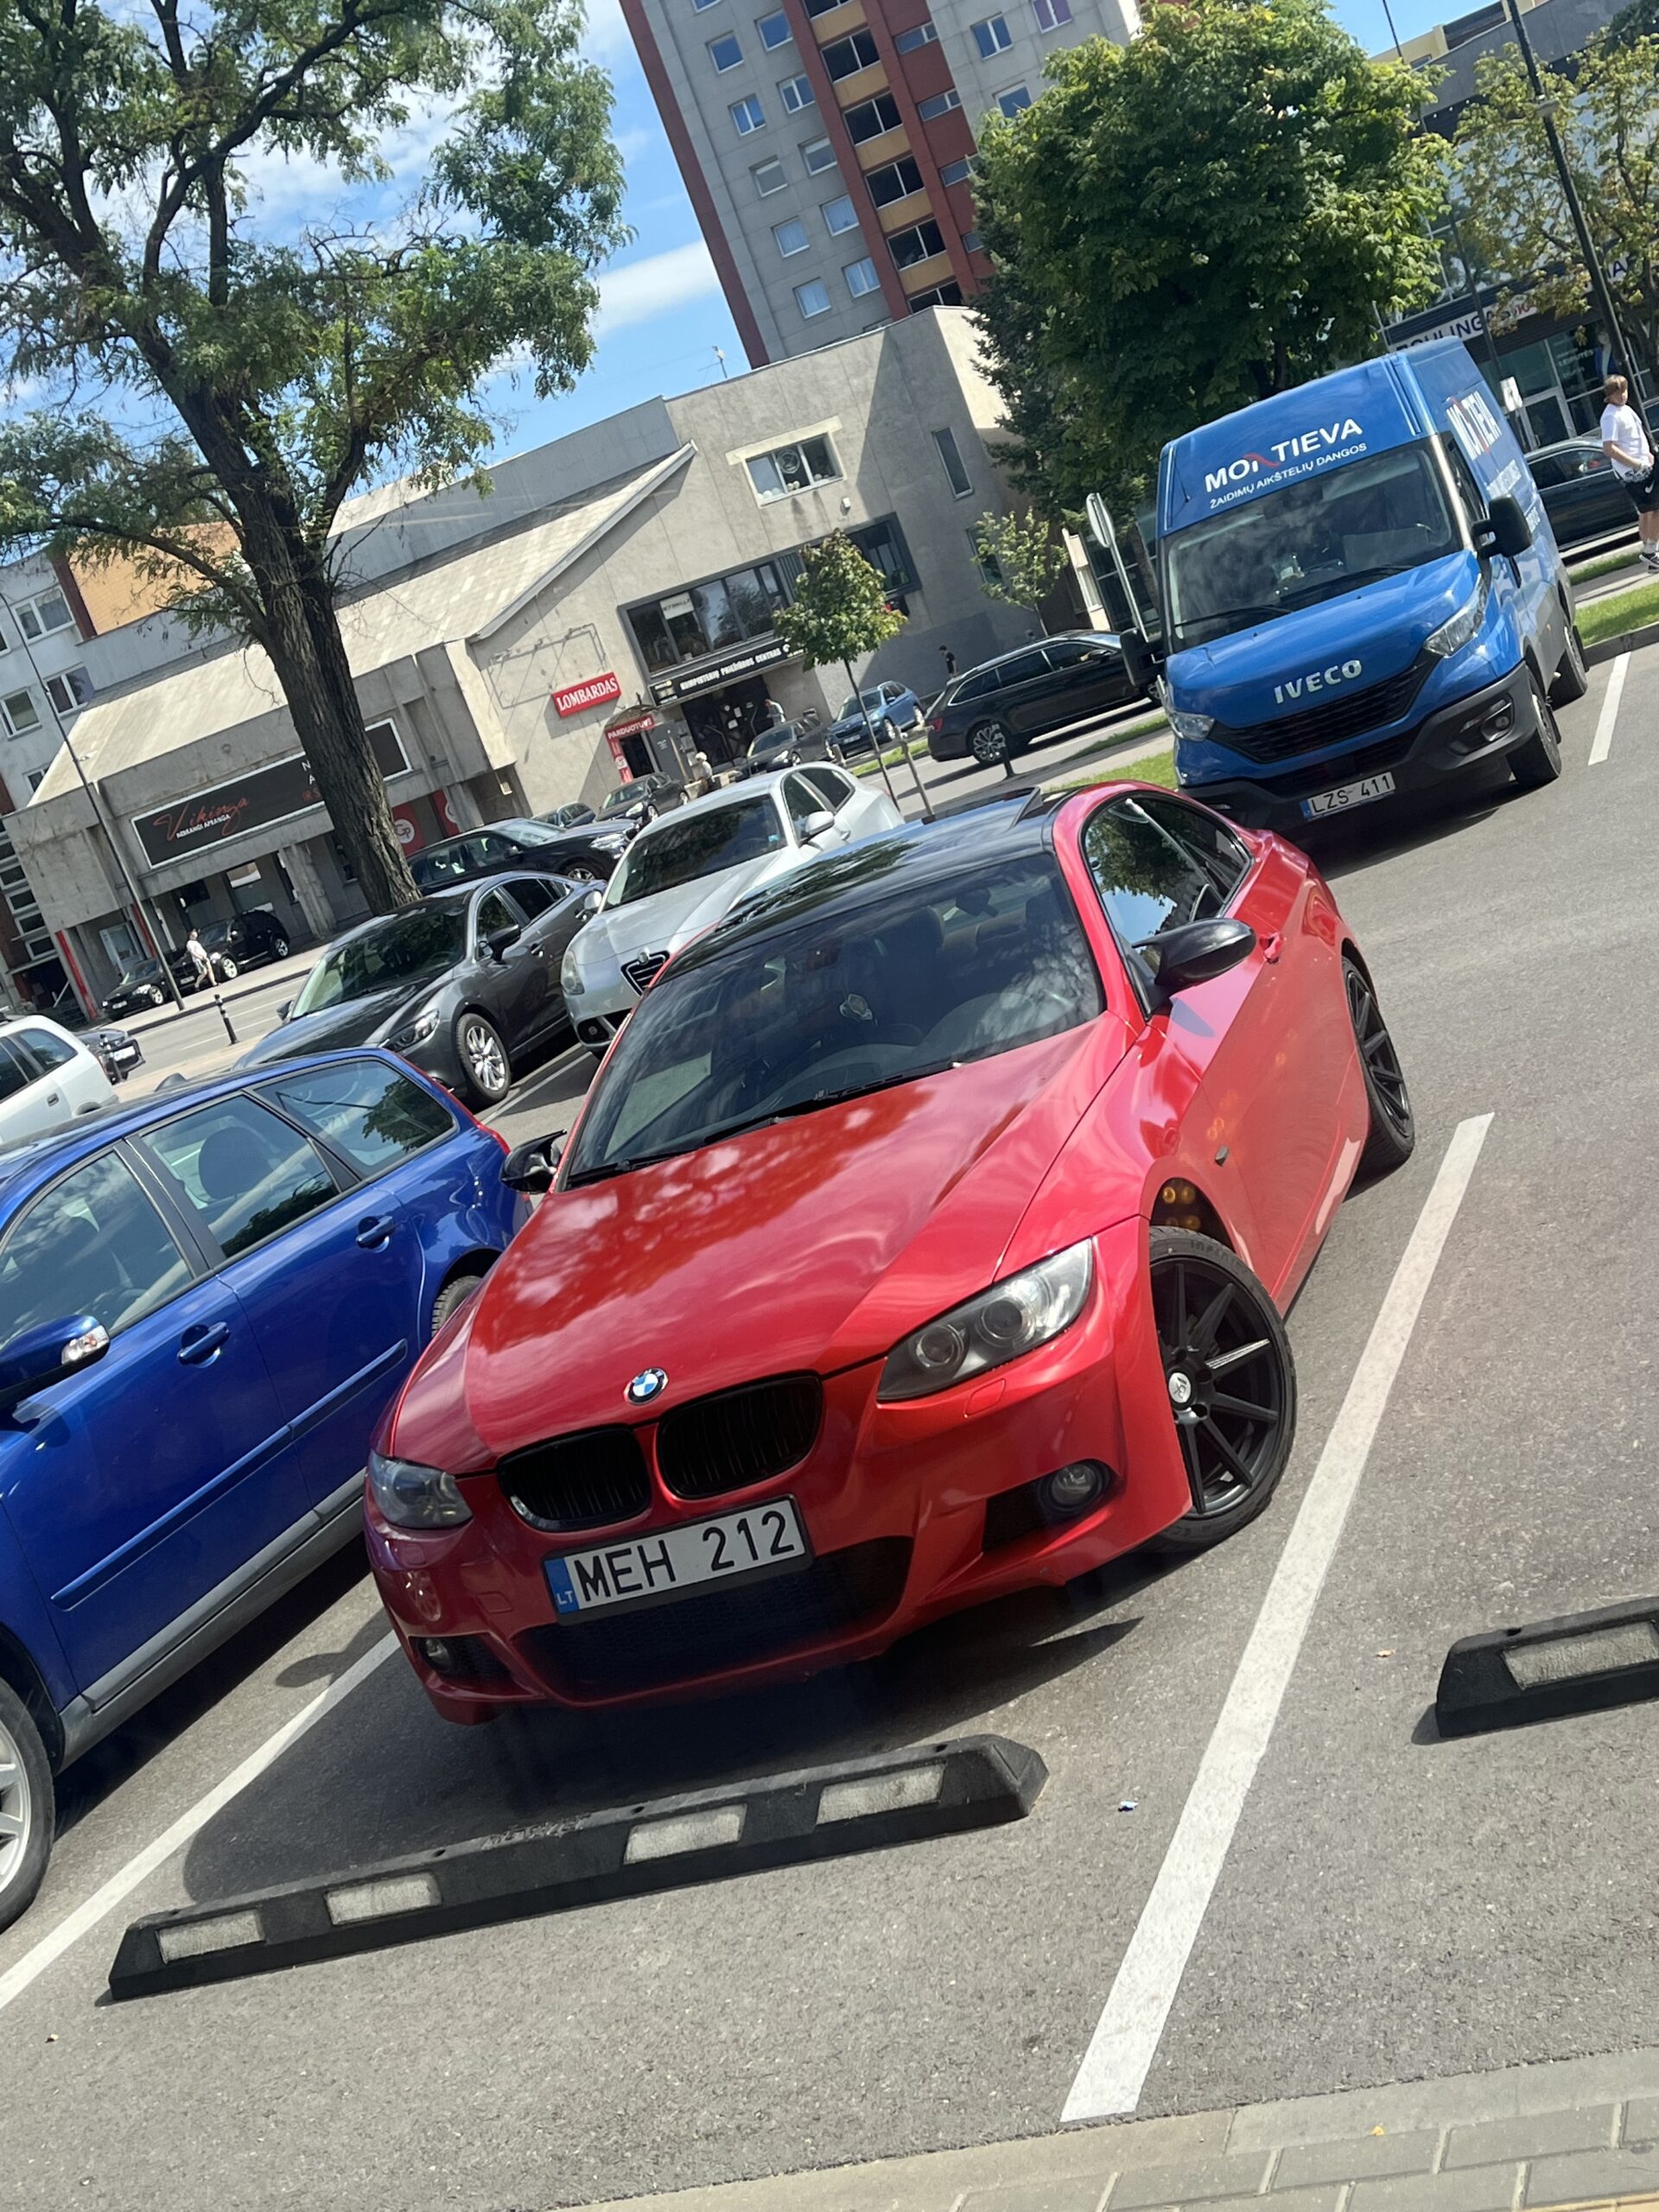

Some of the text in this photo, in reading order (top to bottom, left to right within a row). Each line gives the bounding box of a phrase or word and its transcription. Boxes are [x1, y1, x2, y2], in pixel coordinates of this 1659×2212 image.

[1210, 442, 1367, 510] ŽAIDIMŲ AIKŠTELIŲ DANGOS
[556, 677, 619, 711] LOMBARDAS
[1274, 659, 1363, 704] IVECO
[1310, 775, 1391, 814] LZS 411
[573, 1510, 796, 1603] MEH 212
[556, 1590, 574, 1605] LT
